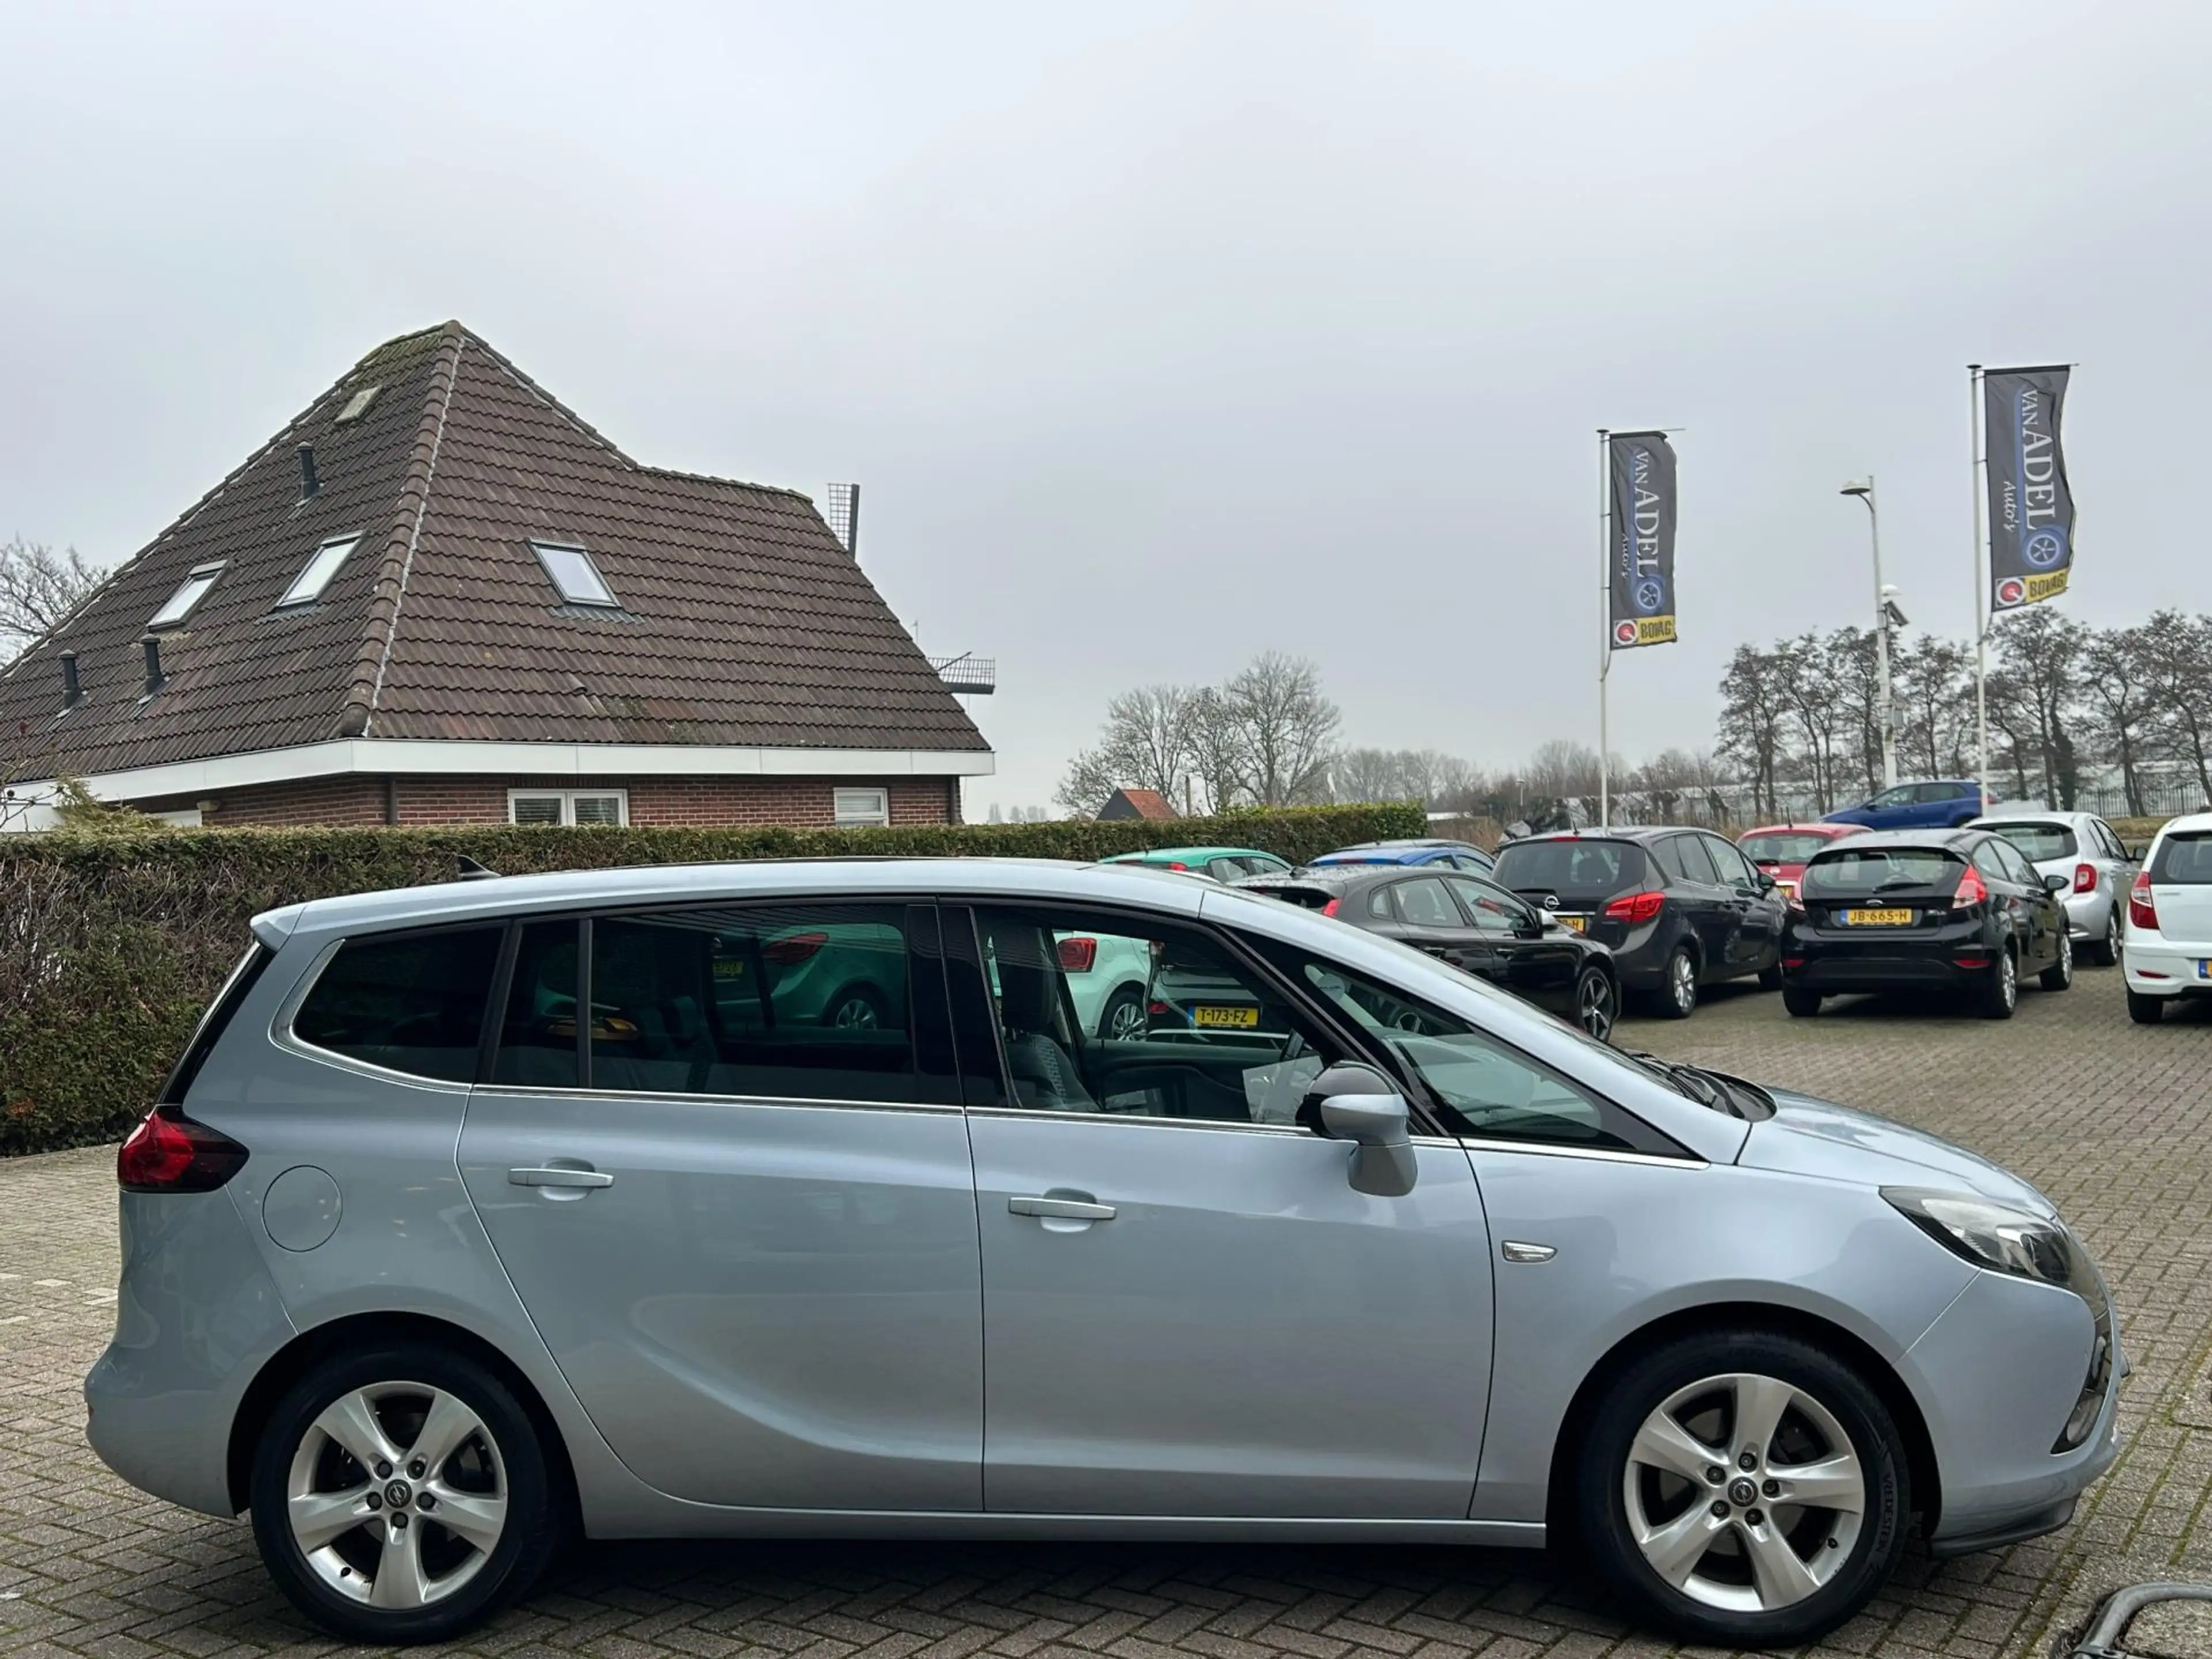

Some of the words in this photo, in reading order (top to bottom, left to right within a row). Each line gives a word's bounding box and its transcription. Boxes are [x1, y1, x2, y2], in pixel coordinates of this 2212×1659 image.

[2021, 389, 2038, 425] VAN
[1635, 452, 1649, 484] VAN
[2022, 427, 2056, 531] ADEL
[1634, 485, 1660, 578] ADEL
[1850, 910, 1907, 922] JB-665-H
[1200, 1008, 1248, 1022] T-173-FZ
